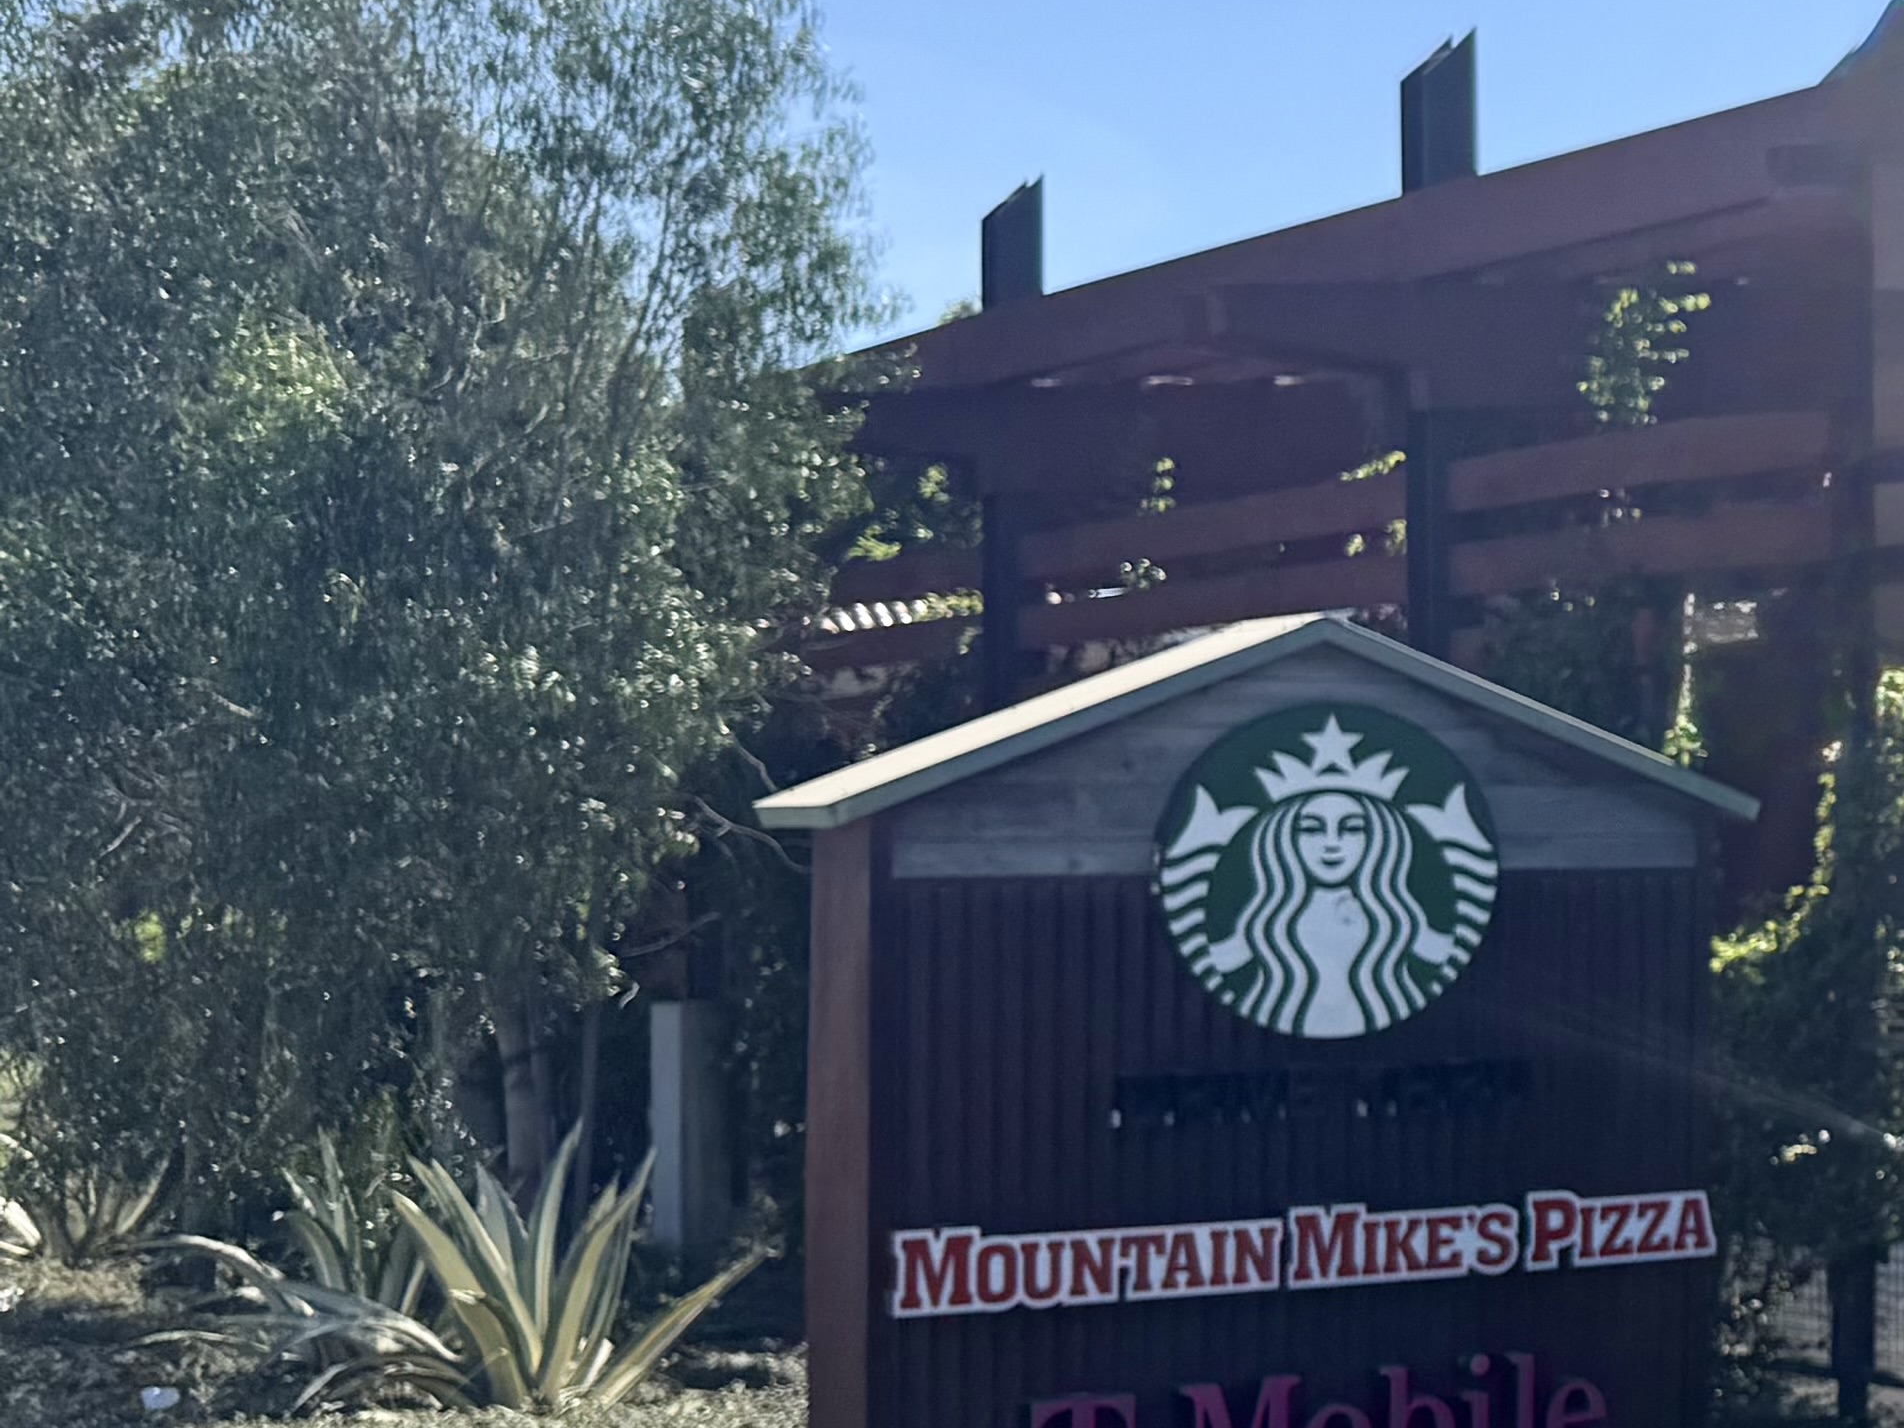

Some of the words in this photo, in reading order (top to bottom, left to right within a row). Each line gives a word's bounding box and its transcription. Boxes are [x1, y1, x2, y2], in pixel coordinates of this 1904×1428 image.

[898, 1222, 1280, 1312] MOUNTAIN
[1291, 1209, 1515, 1282] MIKE'S
[1529, 1196, 1713, 1264] PIZZA
